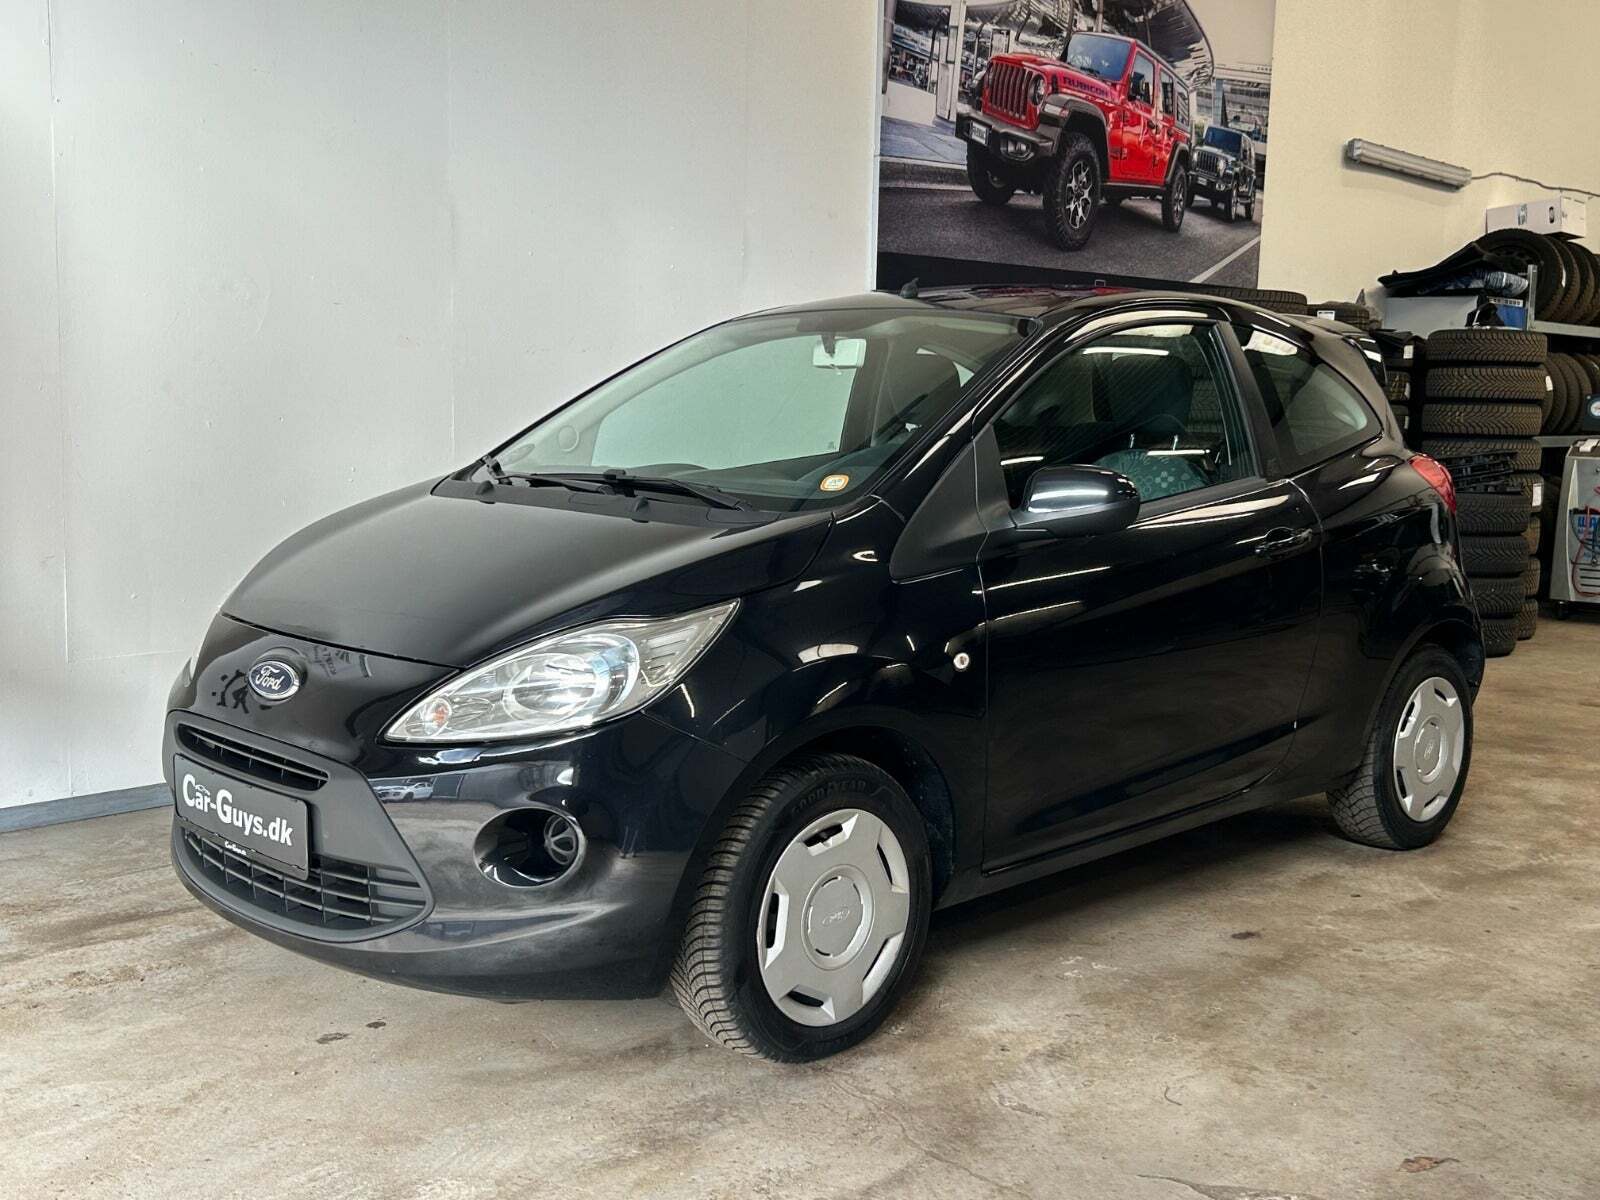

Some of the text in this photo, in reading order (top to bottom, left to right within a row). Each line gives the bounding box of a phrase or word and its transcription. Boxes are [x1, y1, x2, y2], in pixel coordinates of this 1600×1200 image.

[1063, 76, 1109, 99] RUBICON
[255, 665, 285, 690] Ford
[182, 773, 293, 846] Car-Guys.dk
